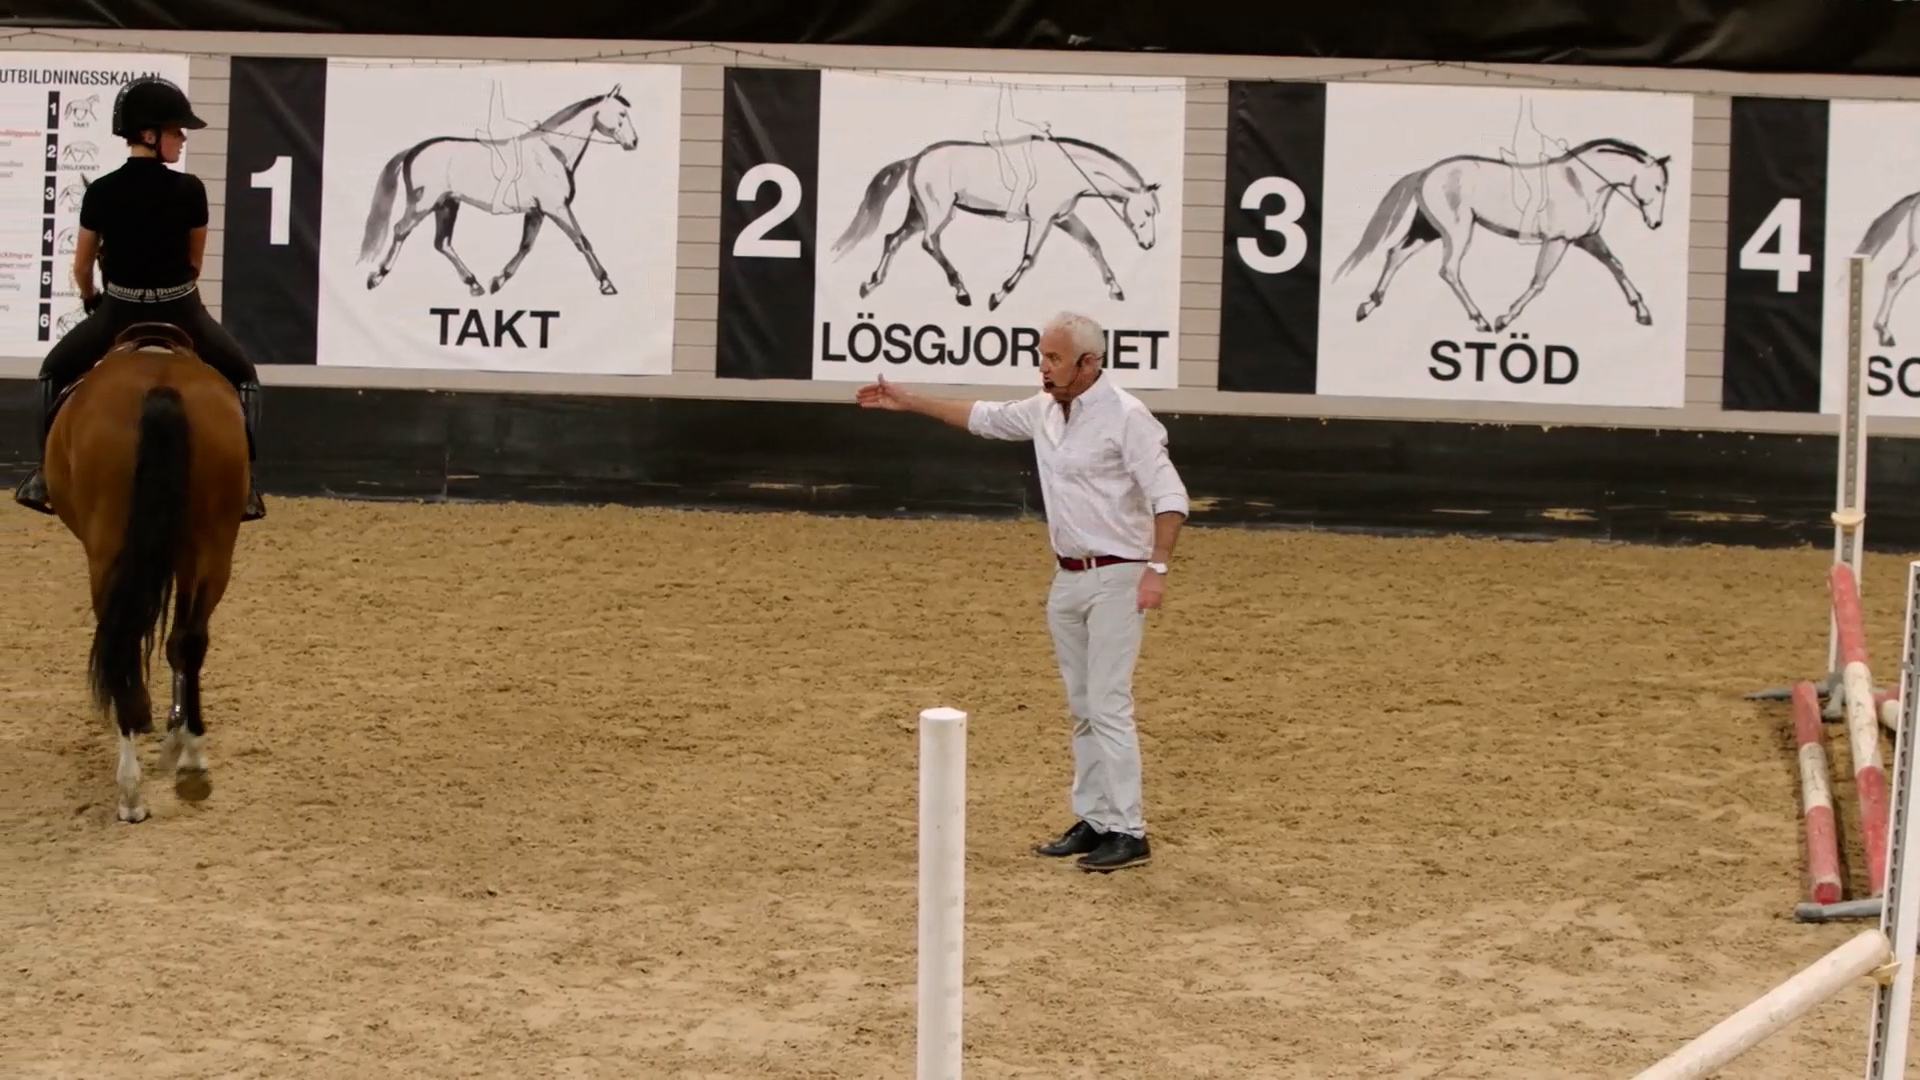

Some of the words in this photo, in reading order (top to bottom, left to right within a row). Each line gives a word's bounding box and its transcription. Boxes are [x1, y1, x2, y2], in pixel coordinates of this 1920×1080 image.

[50, 102, 57, 116] 1
[47, 144, 57, 158] 2
[45, 187, 55, 201] 3
[250, 156, 293, 246] 1
[733, 163, 802, 259] 2
[44, 229, 53, 243] 4
[1237, 176, 1307, 273] 3
[1739, 198, 1812, 293] 4
[42, 271, 51, 285] 5
[39, 314, 50, 328] 6
[430, 307, 560, 349] TAKT
[821, 312, 1170, 371] LÖSGJORET
[1428, 333, 1579, 386] STÖD
